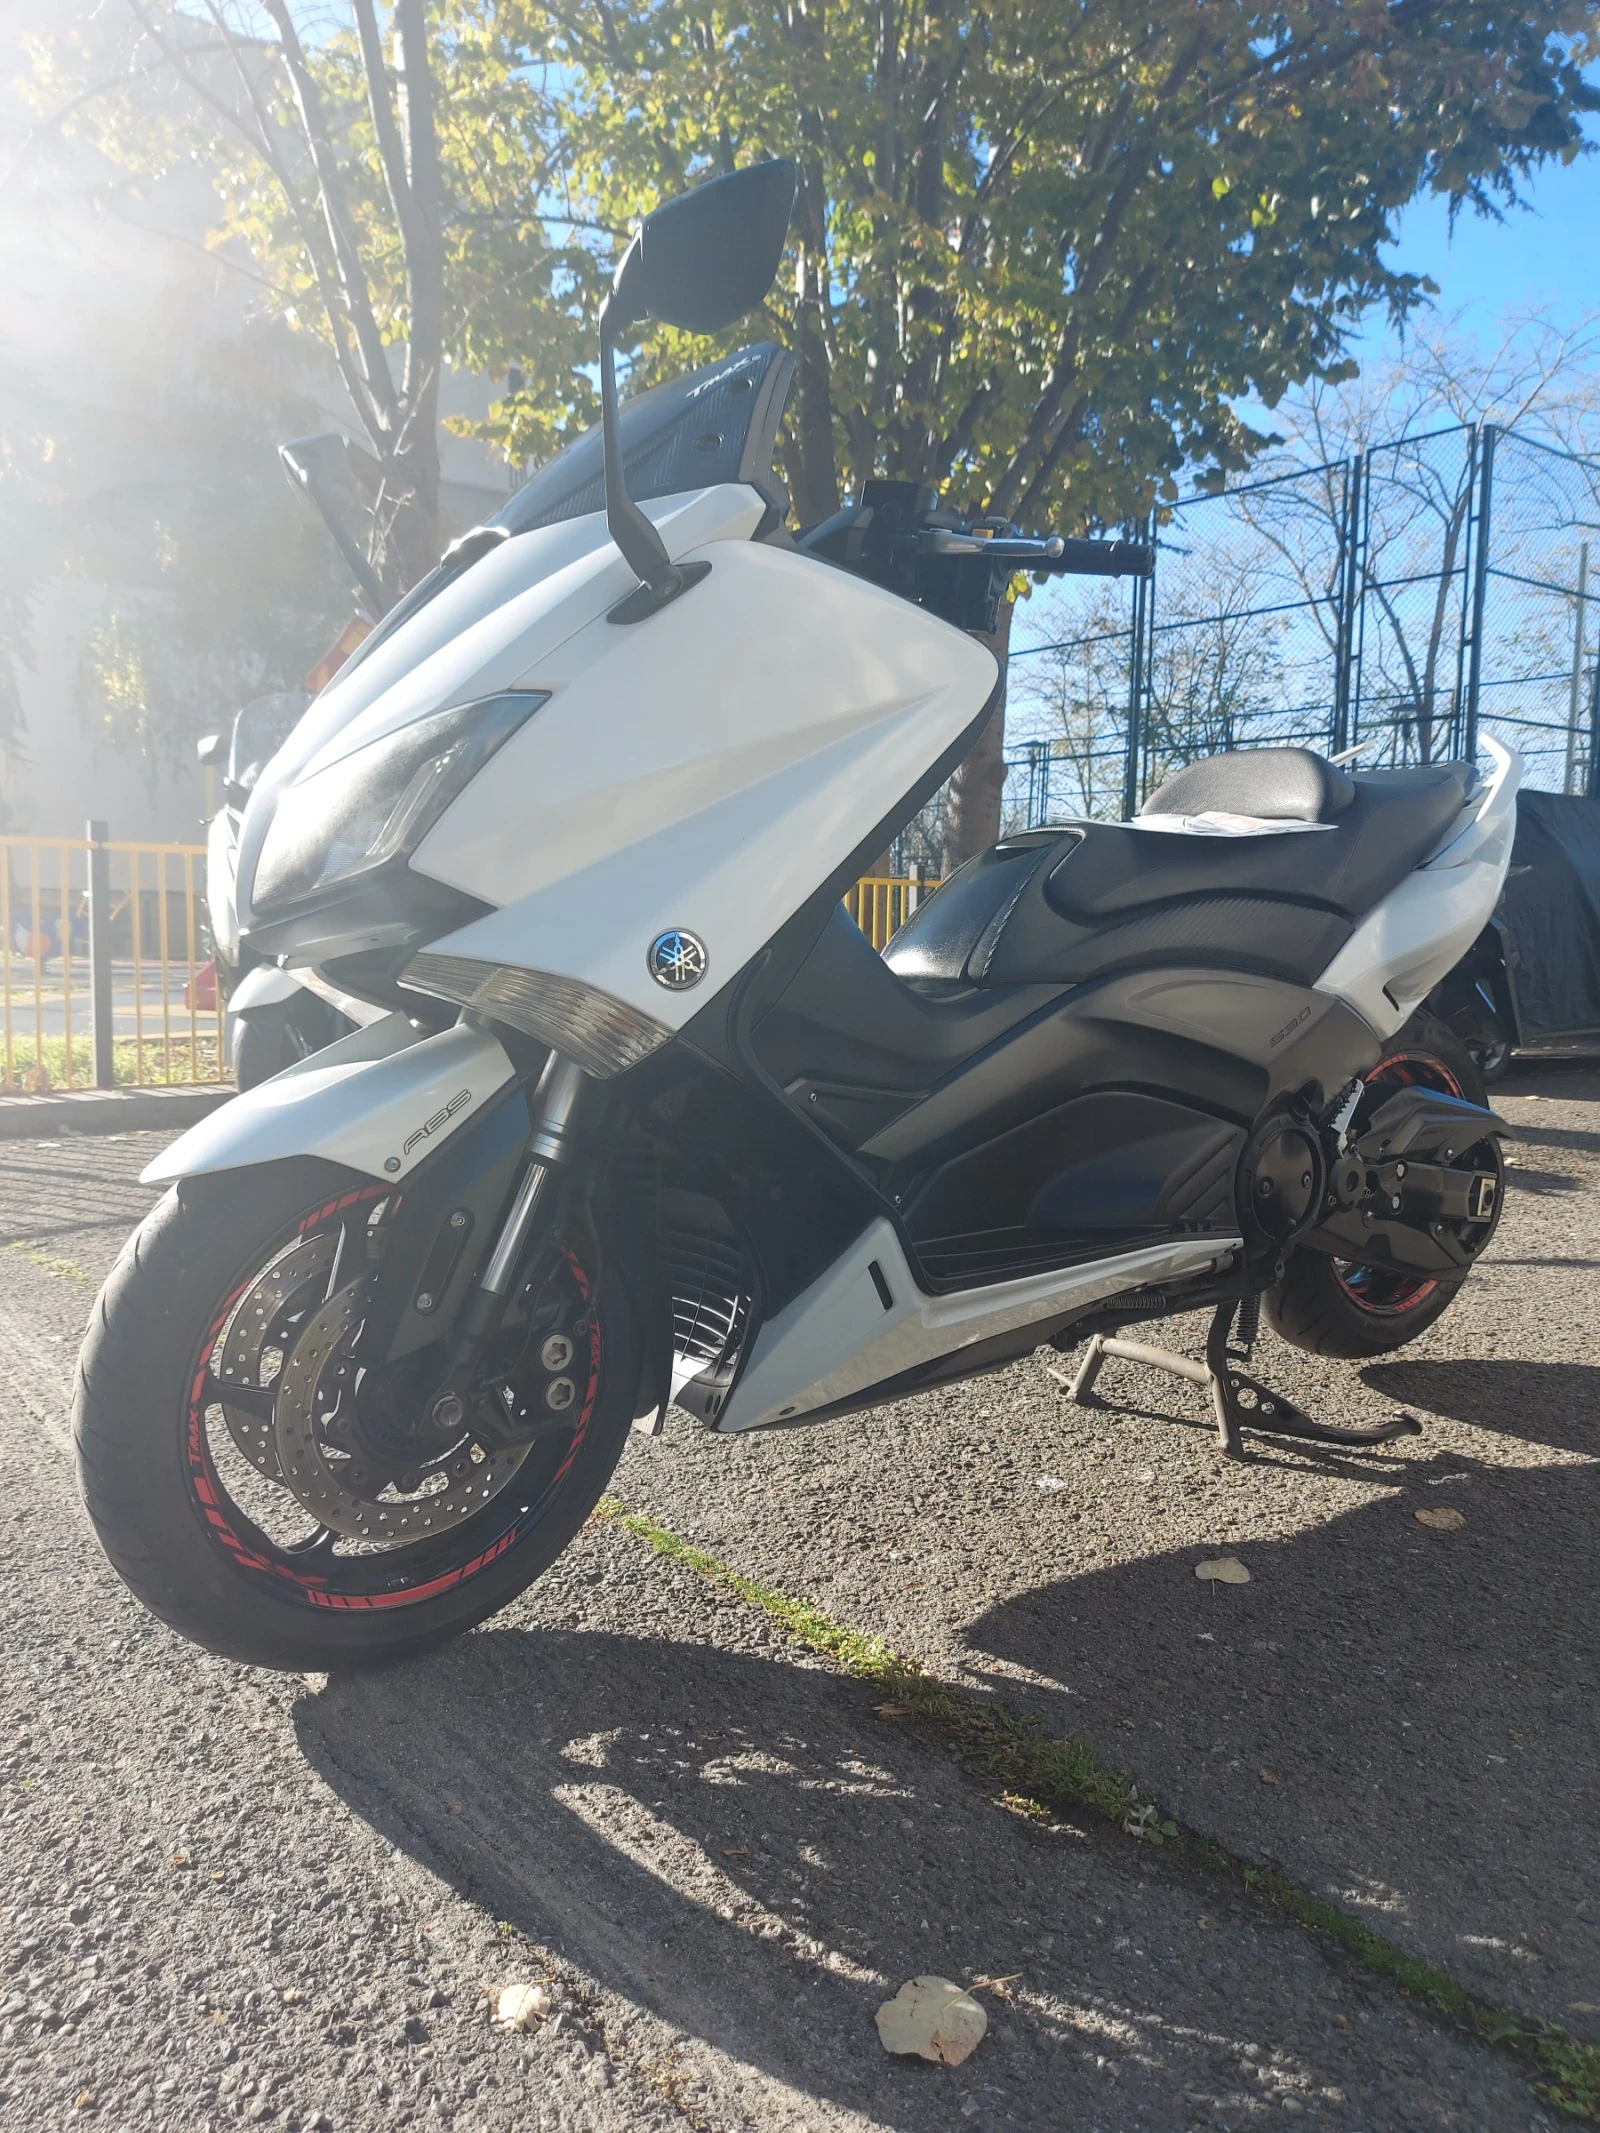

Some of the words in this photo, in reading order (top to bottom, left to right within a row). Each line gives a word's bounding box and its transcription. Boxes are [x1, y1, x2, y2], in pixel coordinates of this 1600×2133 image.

[1269, 1006, 1311, 1049] 530
[403, 1088, 472, 1156] ABS
[187, 1408, 201, 1467] TMAX
